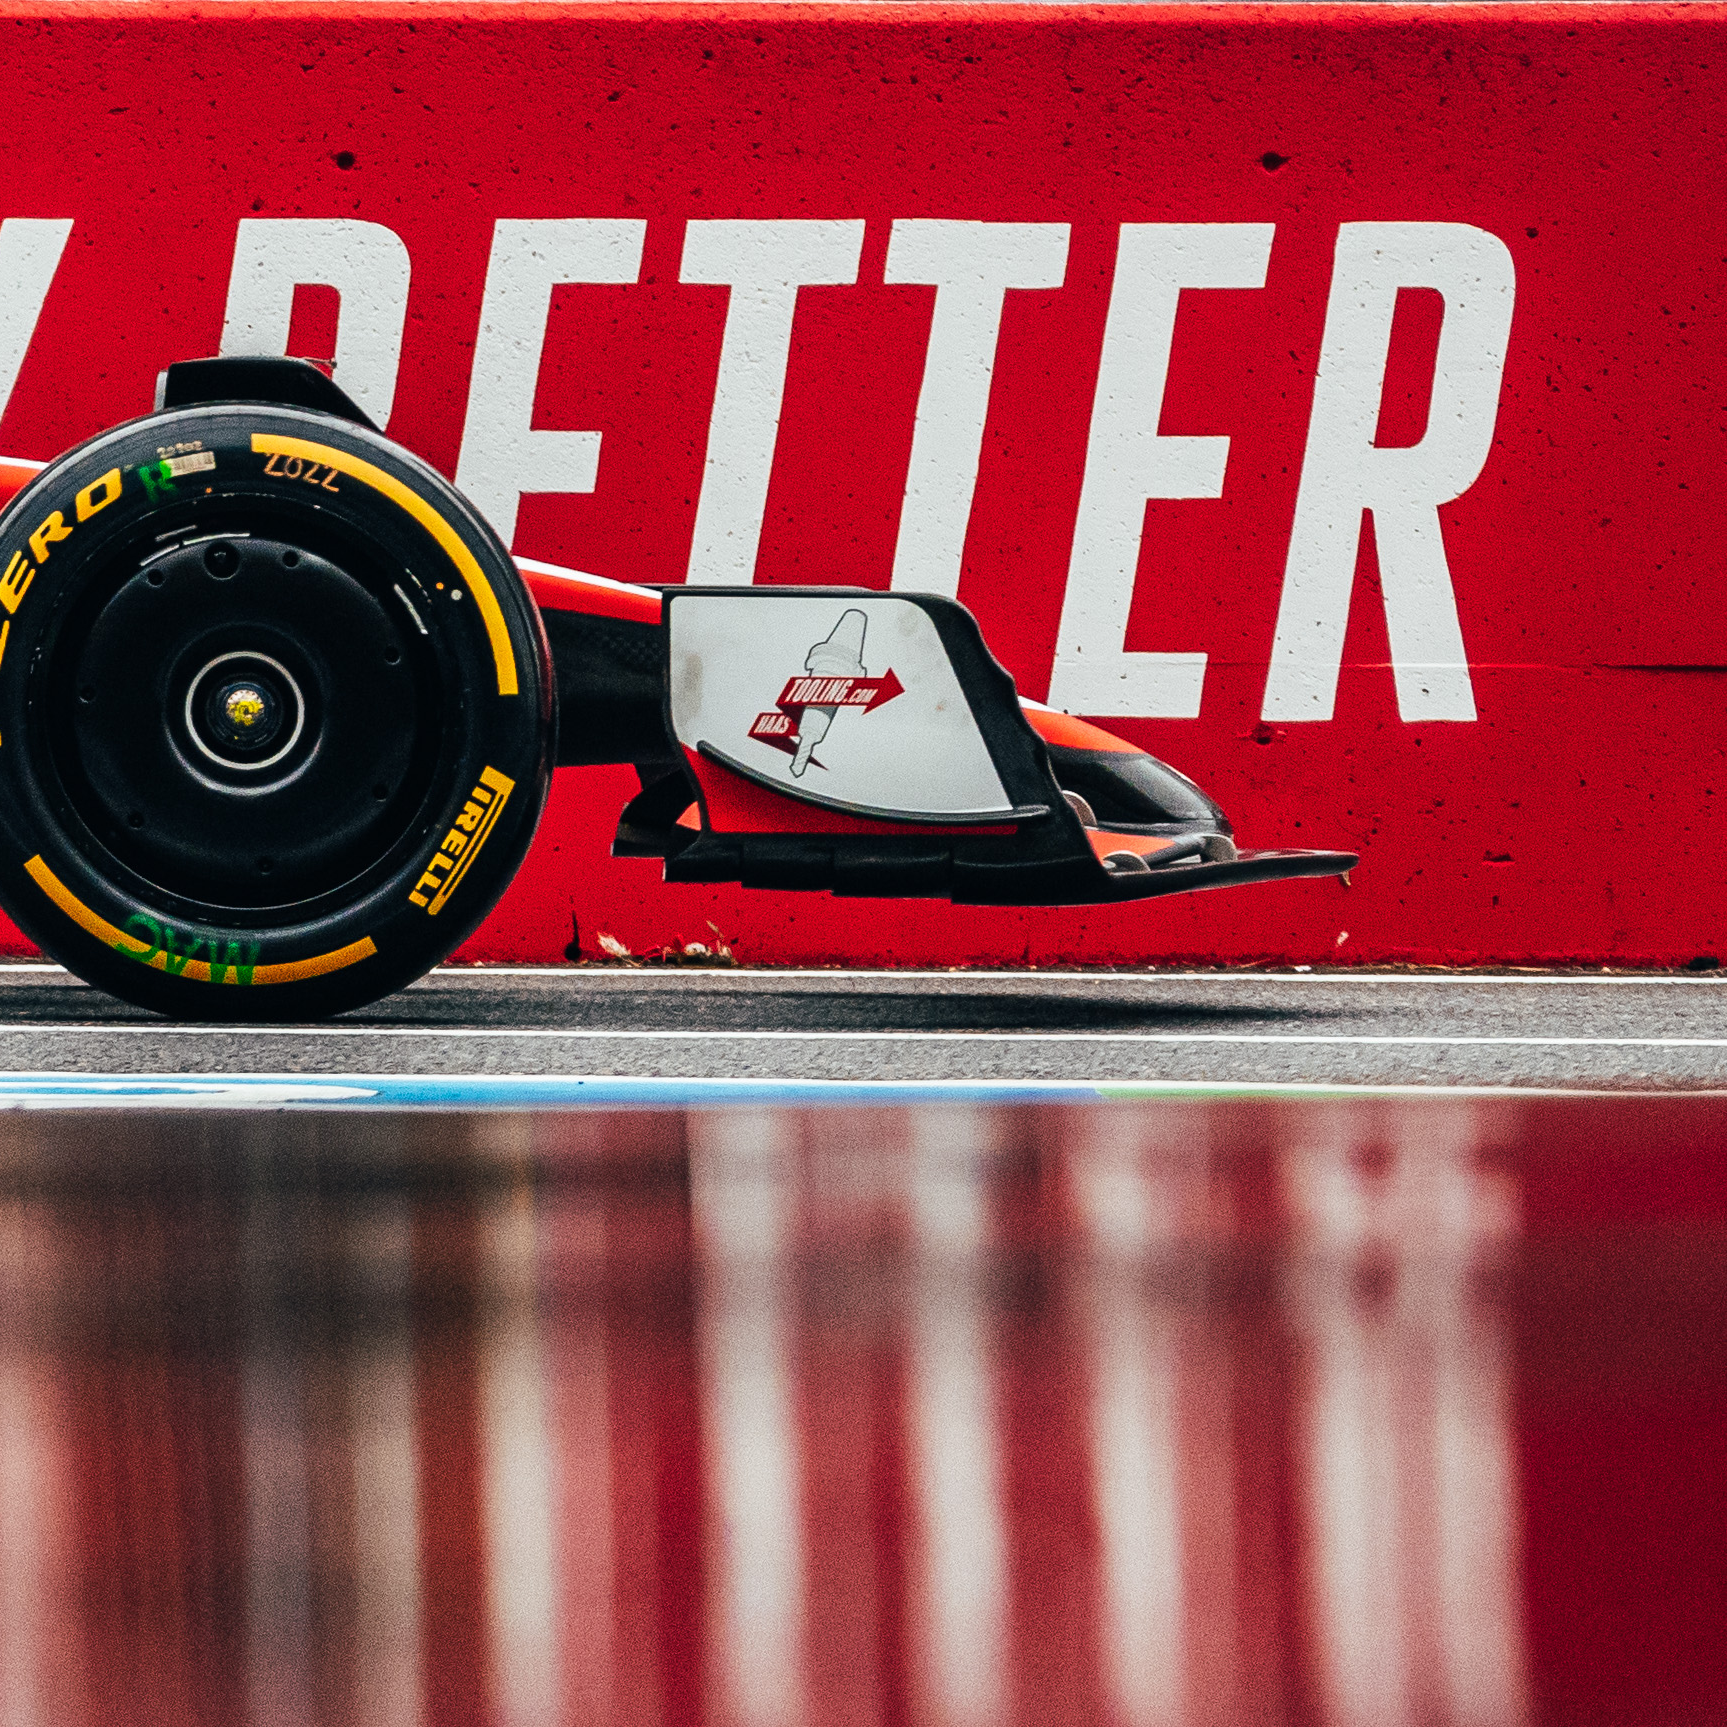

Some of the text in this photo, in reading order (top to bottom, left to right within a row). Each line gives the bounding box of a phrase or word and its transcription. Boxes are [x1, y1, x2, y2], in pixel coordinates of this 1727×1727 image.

[784, 678, 879, 704] TOOLING.COM
[753, 714, 792, 735] HAAS
[407, 764, 517, 917] PIRELLI
[115, 911, 262, 986] MAG
